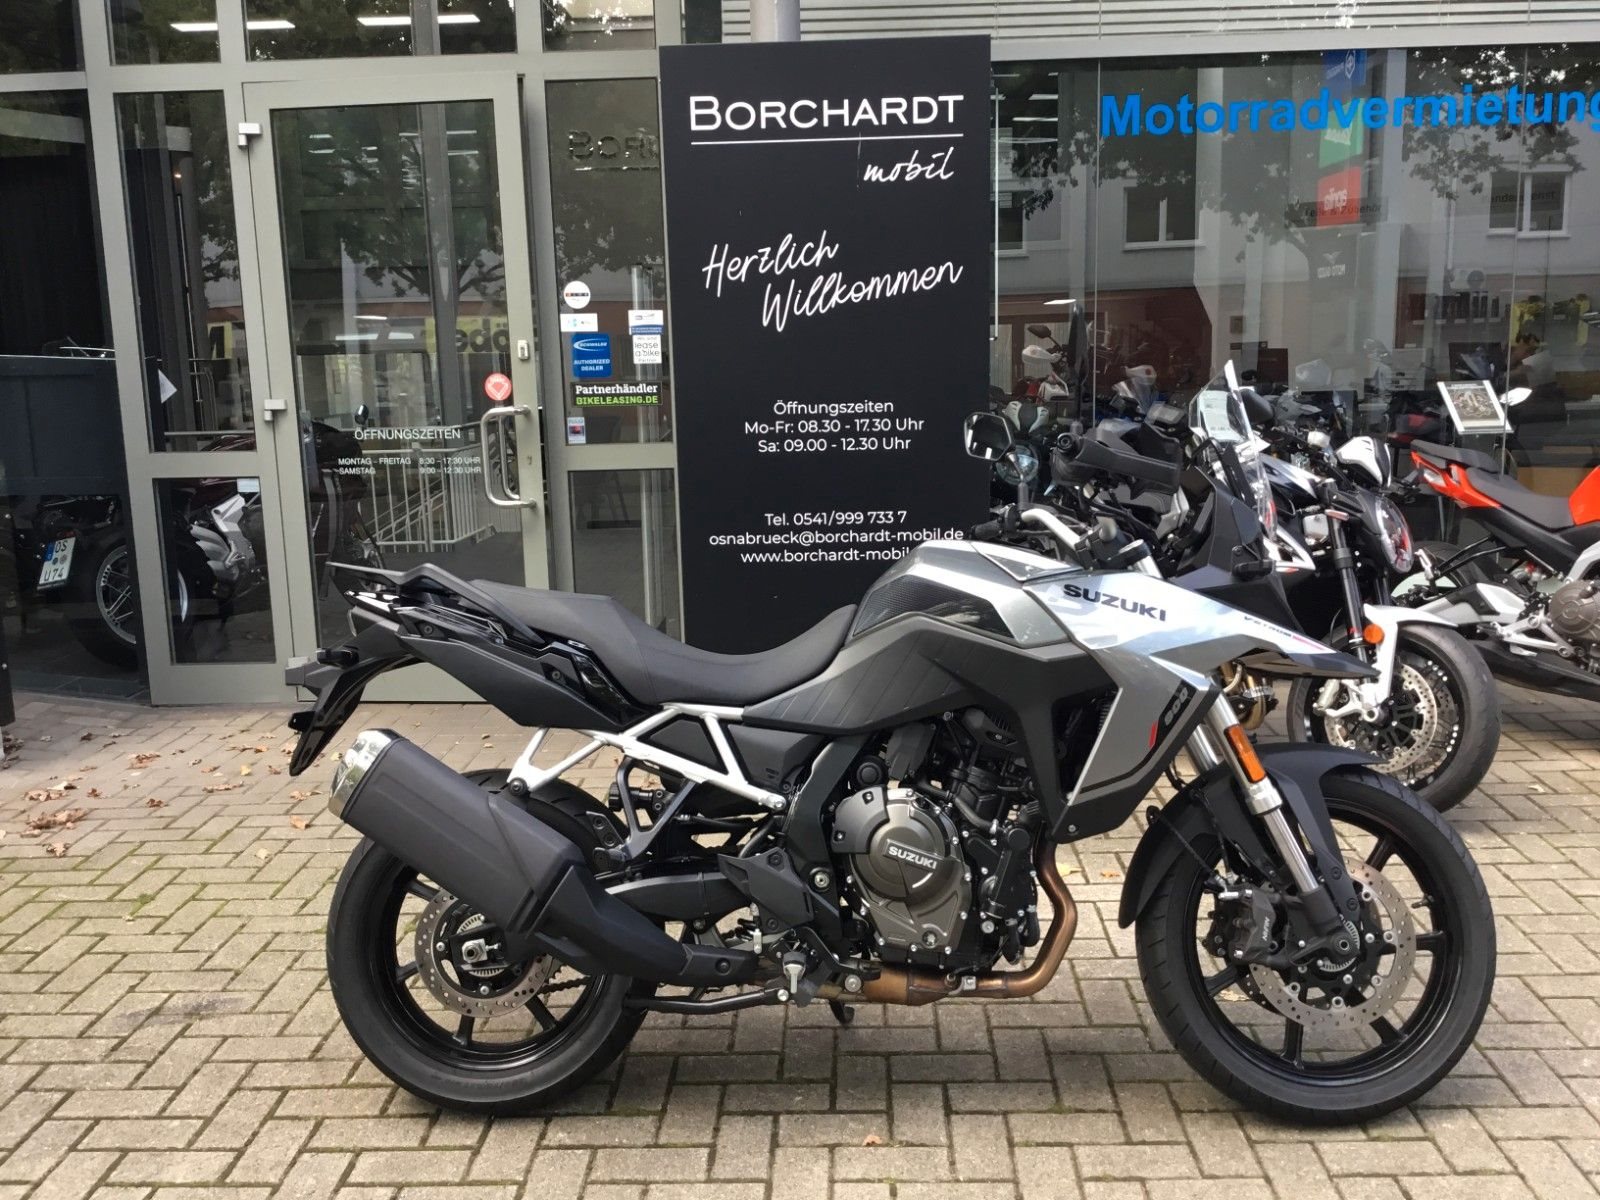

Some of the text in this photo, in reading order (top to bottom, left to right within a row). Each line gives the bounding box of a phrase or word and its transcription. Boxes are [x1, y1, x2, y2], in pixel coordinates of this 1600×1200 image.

[689, 94, 964, 131] BORCHARDT
[863, 146, 954, 182] mobil
[702, 230, 839, 297] Herzlich
[762, 261, 964, 332] Willkommen
[575, 383, 658, 394] Partnerhändler
[576, 395, 658, 405] BIKELEASING.DE
[774, 400, 894, 416] Öffnungszeiten
[354, 428, 461, 440] ÖFFNUNGSZEITEN
[745, 420, 794, 434] Mo-Fr:
[798, 420, 841, 433] 08.30
[854, 419, 891, 432] 17.30
[896, 418, 924, 431] Uhr
[758, 438, 780, 452] Sa:
[784, 438, 827, 452] 09.00
[841, 437, 878, 451] 12.30
[882, 437, 911, 450] Uhr
[379, 457, 412, 465] FREITAG
[339, 467, 376, 475] SAMSTAG
[765, 510, 907, 527] Tel. 0541/999 733 7
[709, 528, 964, 546] osnabrueck@borchardt-mobil.de
[1063, 583, 1167, 622] SUZUKI
[888, 846, 937, 870] SUZUKI
